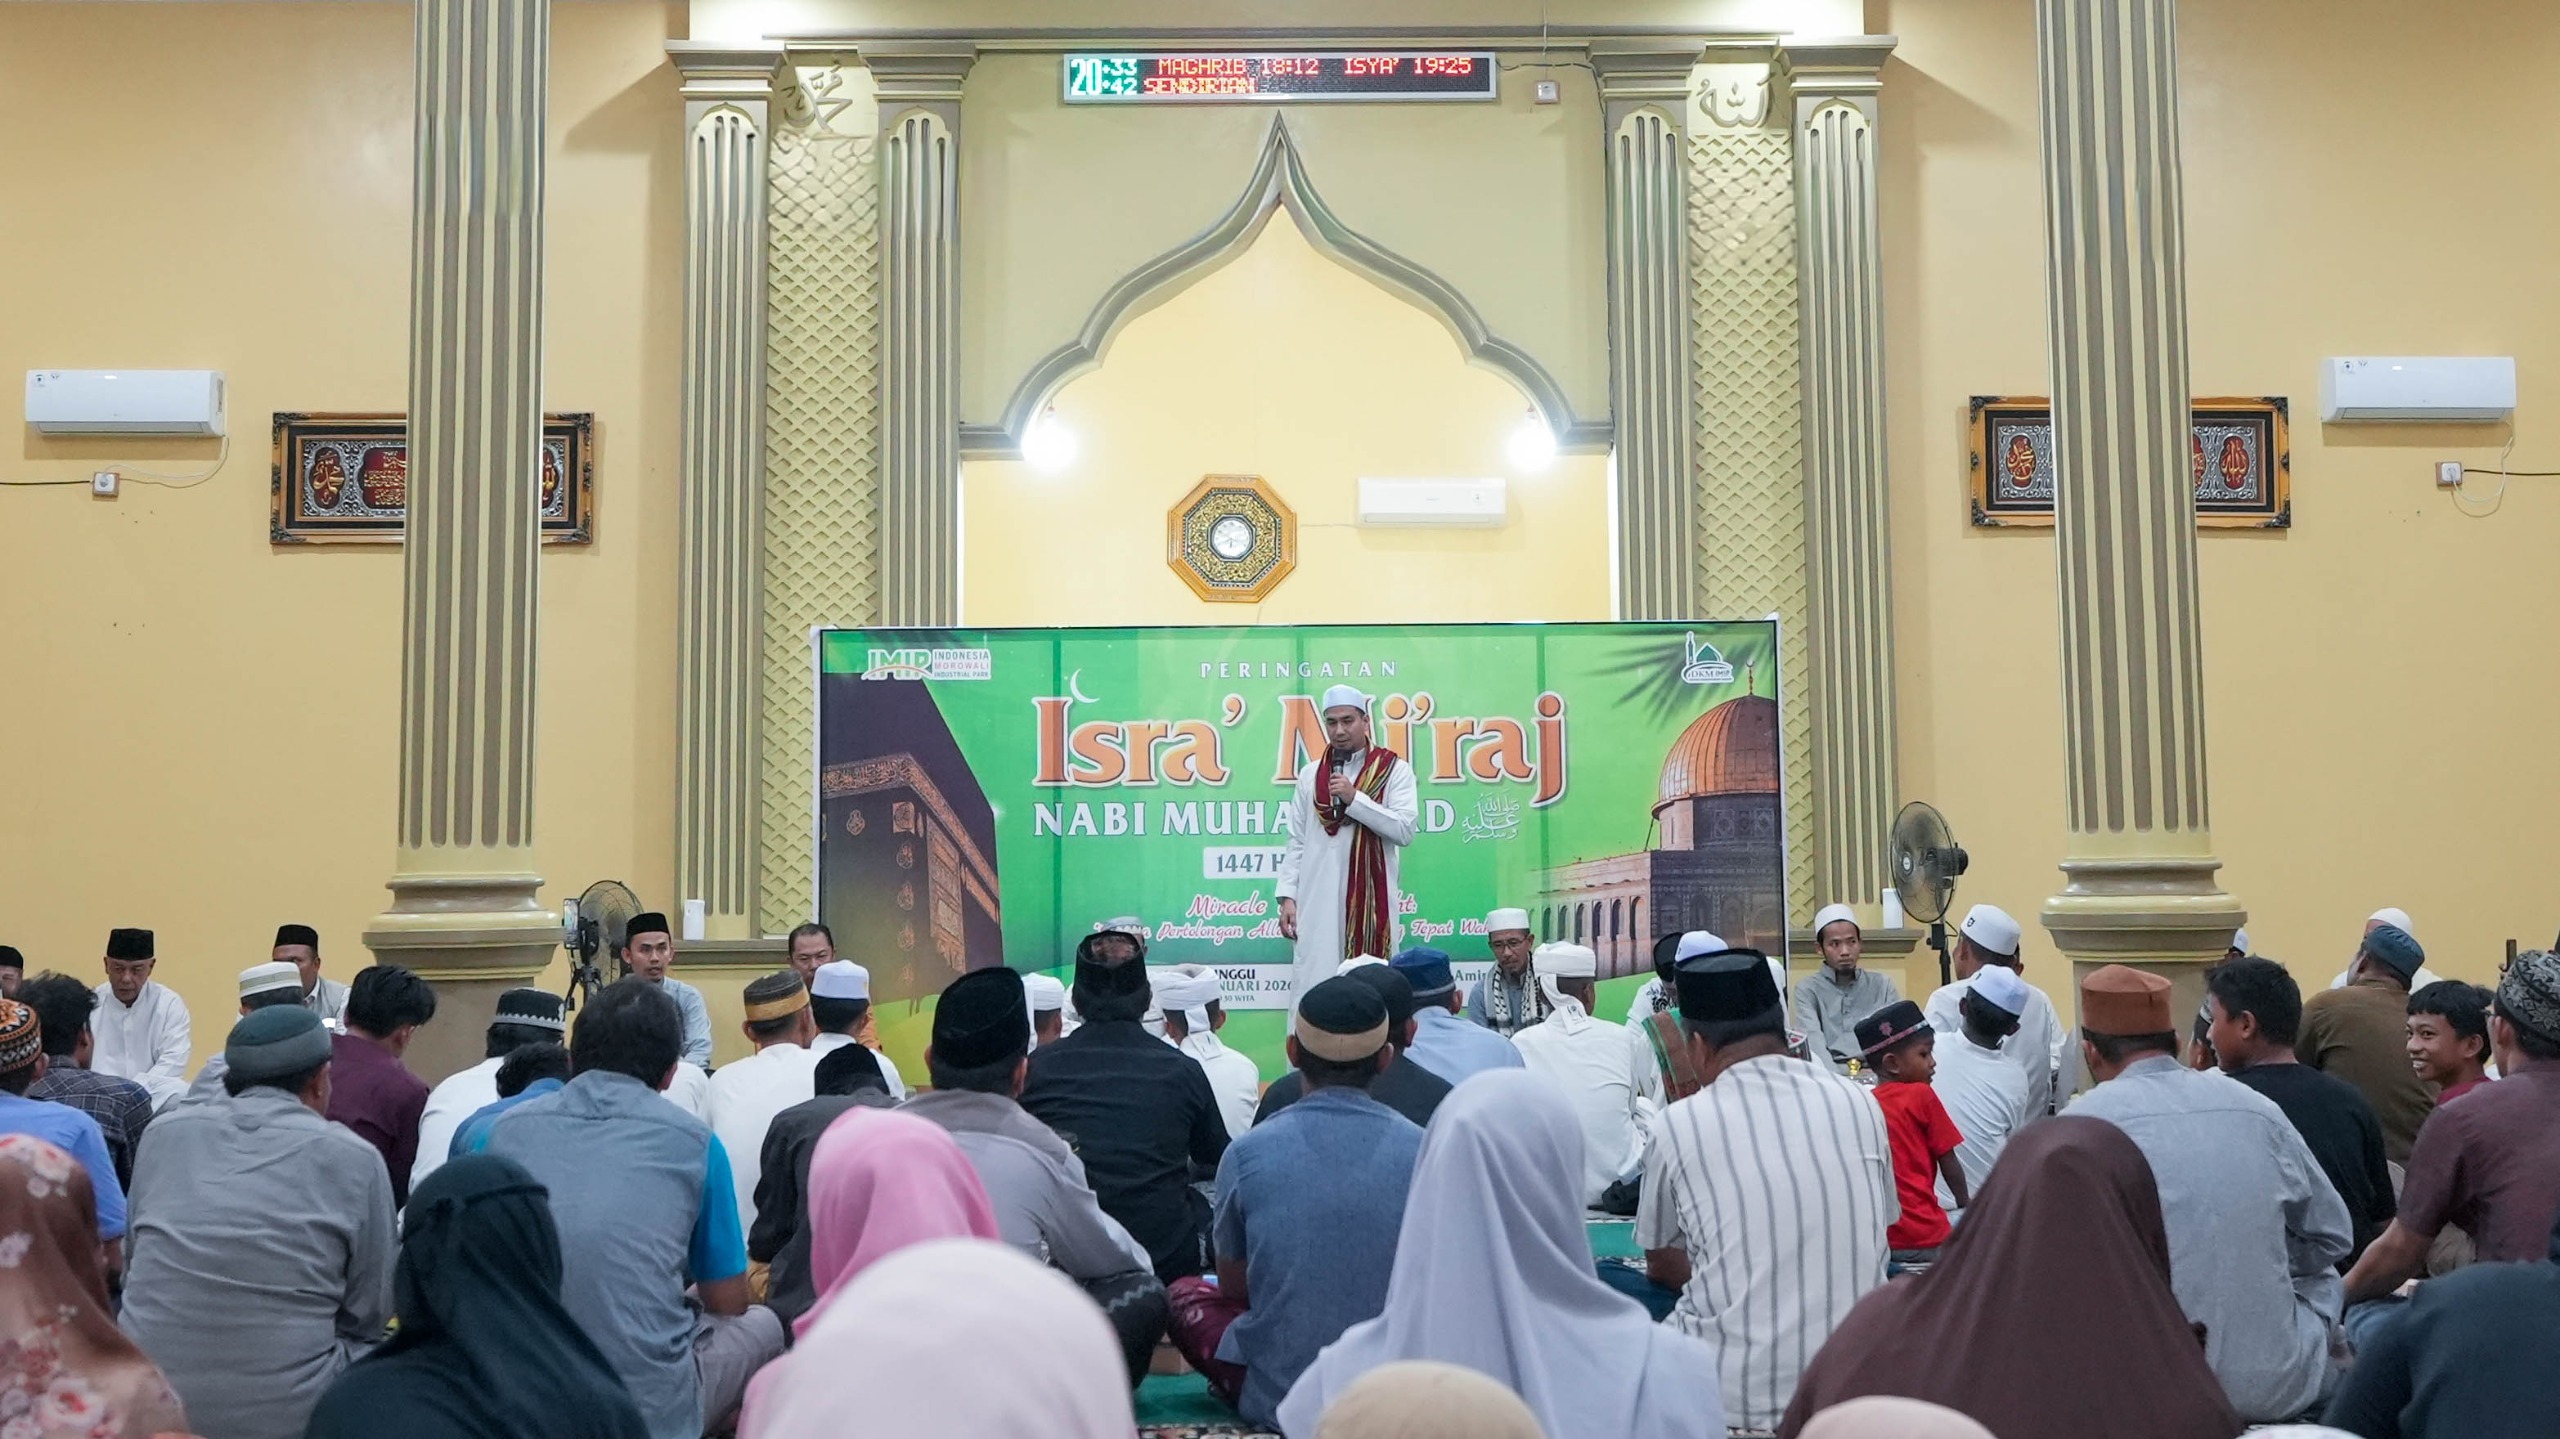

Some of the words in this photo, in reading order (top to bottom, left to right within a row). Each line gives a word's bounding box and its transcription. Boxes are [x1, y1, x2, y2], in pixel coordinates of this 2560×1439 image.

[1158, 58, 1249, 76] MAGHRIB
[1261, 58, 1319, 75] 18:12
[1343, 57, 1400, 74] ISYA'
[1413, 57, 1472, 74] 19:25
[866, 648, 932, 680] IMIP
[934, 651, 989, 660] INDONESIA
[934, 661, 989, 670] MOROWALI
[1200, 661, 1397, 678] PERINGATAN
[1031, 693, 1247, 787] Isra'
[1033, 802, 1146, 836] NABI
[1161, 798, 1456, 836] MUHAD
[1217, 854, 1264, 872] 1447
[1188, 893, 1267, 917] Miracle
[1157, 921, 1243, 943] Pertolongan
[1248, 918, 1283, 939] Alla
[1412, 920, 1453, 942] Tepat
